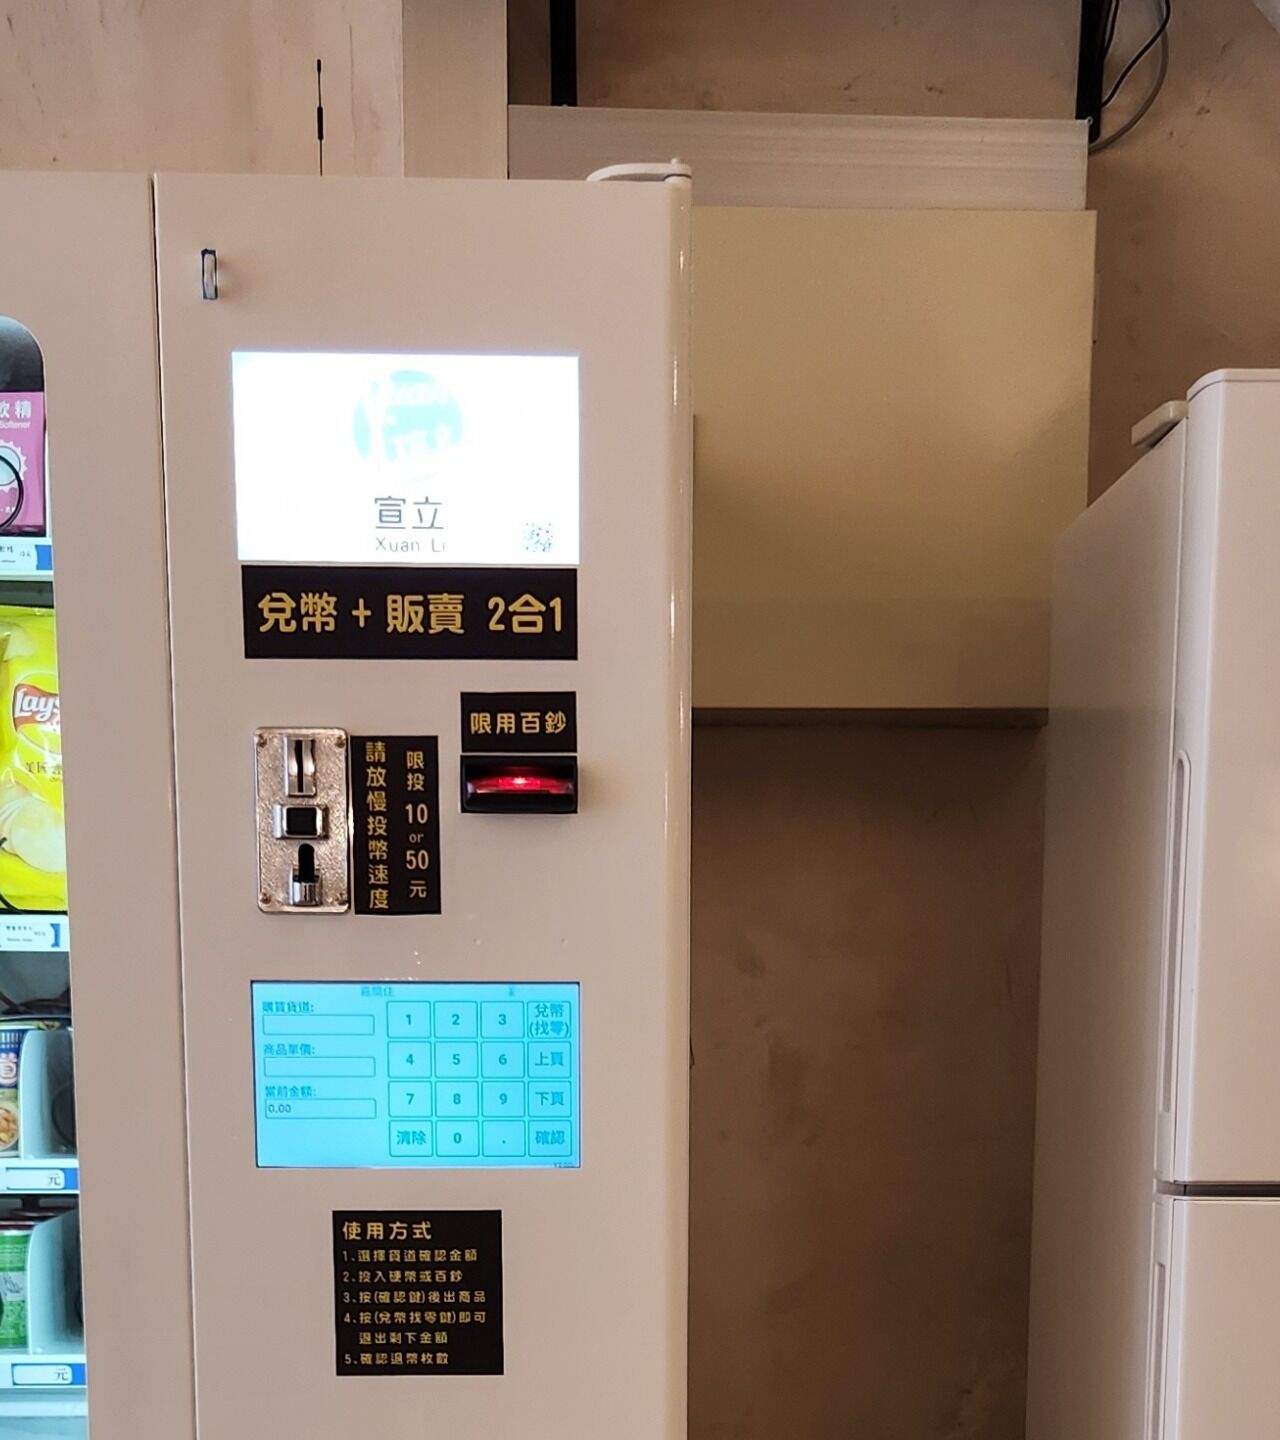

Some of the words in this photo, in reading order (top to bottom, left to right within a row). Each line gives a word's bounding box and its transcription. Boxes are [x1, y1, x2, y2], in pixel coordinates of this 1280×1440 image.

[374, 496, 445, 531] 宣立
[374, 536, 420, 553] Xuan
[431, 536, 447, 553] Li
[258, 592, 338, 634] 兌幣
[386, 593, 466, 635] 販賣
[487, 594, 563, 634] 2合1
[470, 711, 567, 735] 限用百鈔
[405, 751, 426, 792] 限投
[405, 803, 429, 824] 10
[365, 740, 390, 910] 請放慢投幣速度
[408, 831, 425, 844] or
[405, 849, 429, 870] 50
[408, 879, 428, 899] 元
[534, 1003, 564, 1018] 兌幣
[405, 1013, 412, 1025] 1
[451, 1013, 461, 1026] 2
[498, 1013, 508, 1026] 3
[529, 1020, 570, 1039] (找零)
[405, 1053, 415, 1065] 4
[452, 1053, 461, 1066] 5
[498, 1053, 508, 1066] 6
[534, 1051, 565, 1067] 上頁
[405, 1092, 415, 1105] 7
[452, 1092, 462, 1105] 8
[499, 1092, 508, 1105] 9
[535, 1091, 565, 1107] 下頁
[268, 1103, 292, 1114] 0.00
[396, 1129, 427, 1145] 清除
[453, 1132, 462, 1145] 0
[535, 1129, 566, 1146] 確認
[47, 1172, 62, 1186] 元
[342, 1221, 433, 1241] 使用方式
[358, 1331, 449, 1346] 退出剩下金額
[54, 1368, 69, 1381] 元
